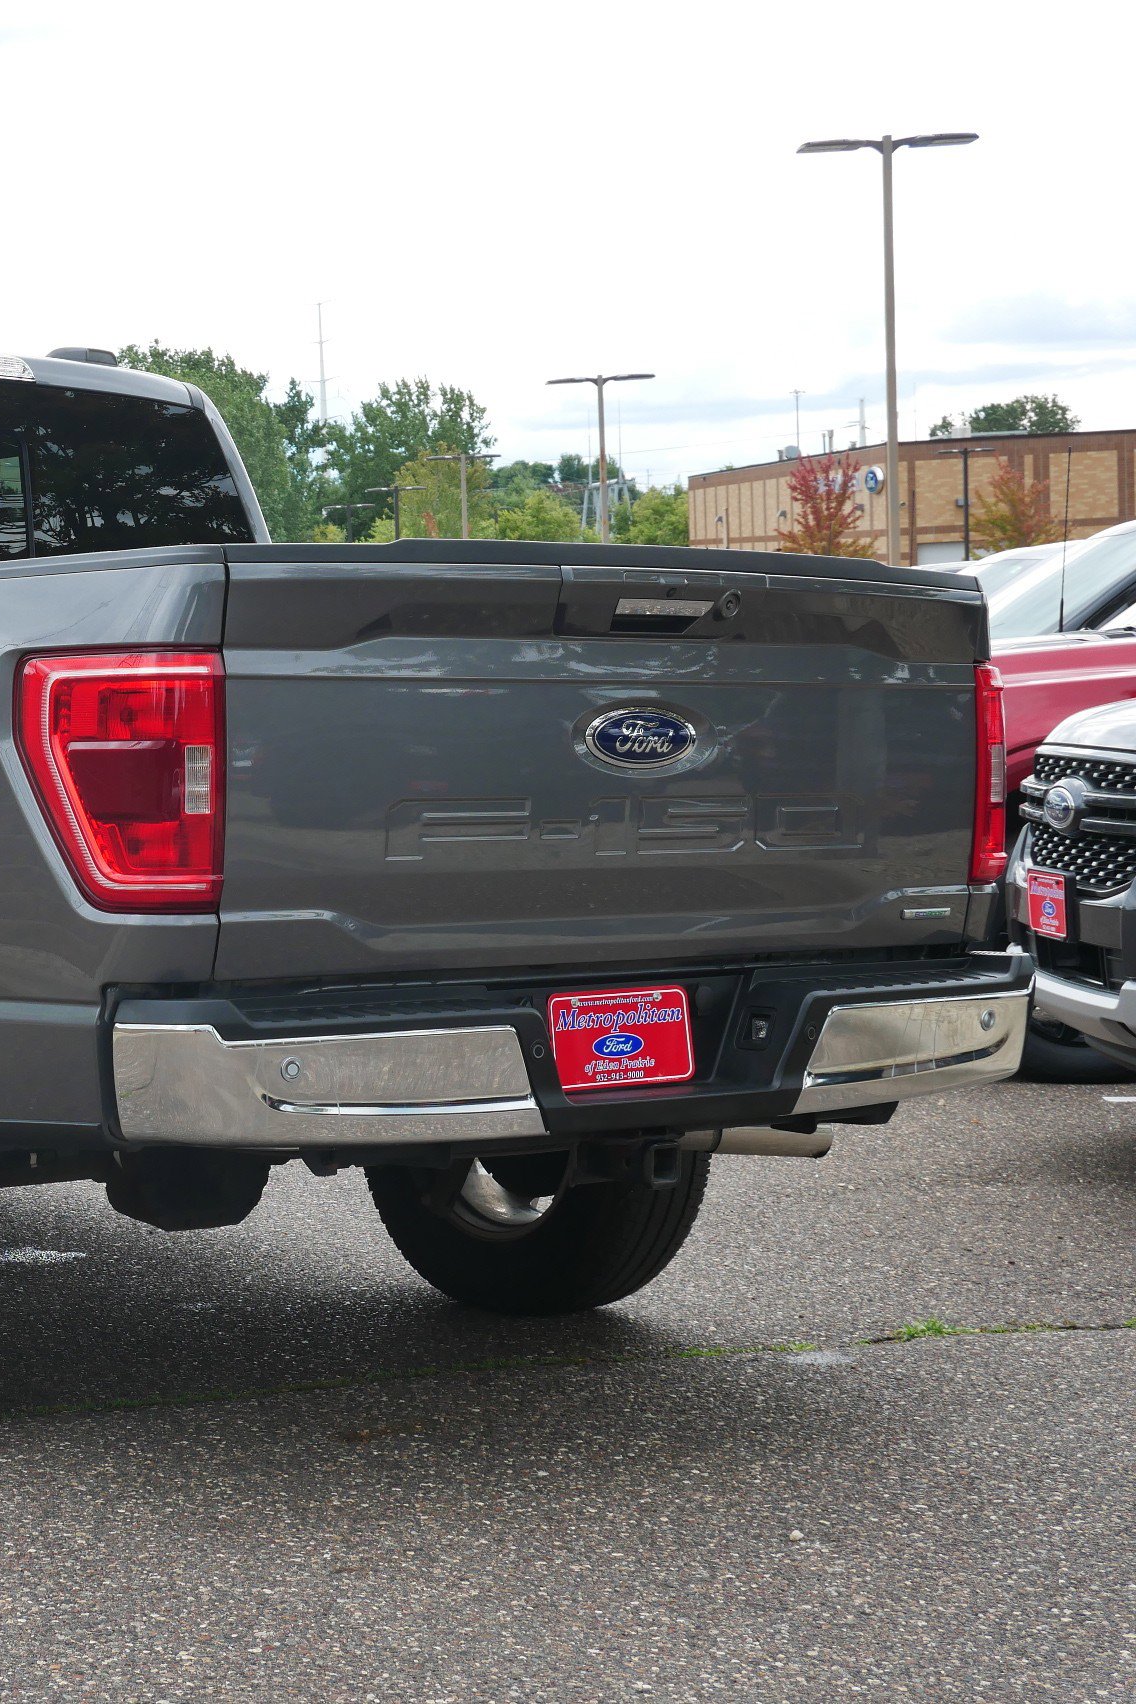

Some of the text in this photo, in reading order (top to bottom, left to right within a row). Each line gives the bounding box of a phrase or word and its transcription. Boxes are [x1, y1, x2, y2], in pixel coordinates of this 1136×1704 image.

[615, 719, 674, 754] Ford
[384, 796, 863, 861] F-150
[578, 995, 654, 1007] www.metropolitanford.com
[556, 1003, 682, 1033] Metropolitan
[603, 1037, 633, 1053] Ford
[584, 1056, 655, 1075] of Eden Prairie
[596, 1070, 644, 1082] 952-943-9000
